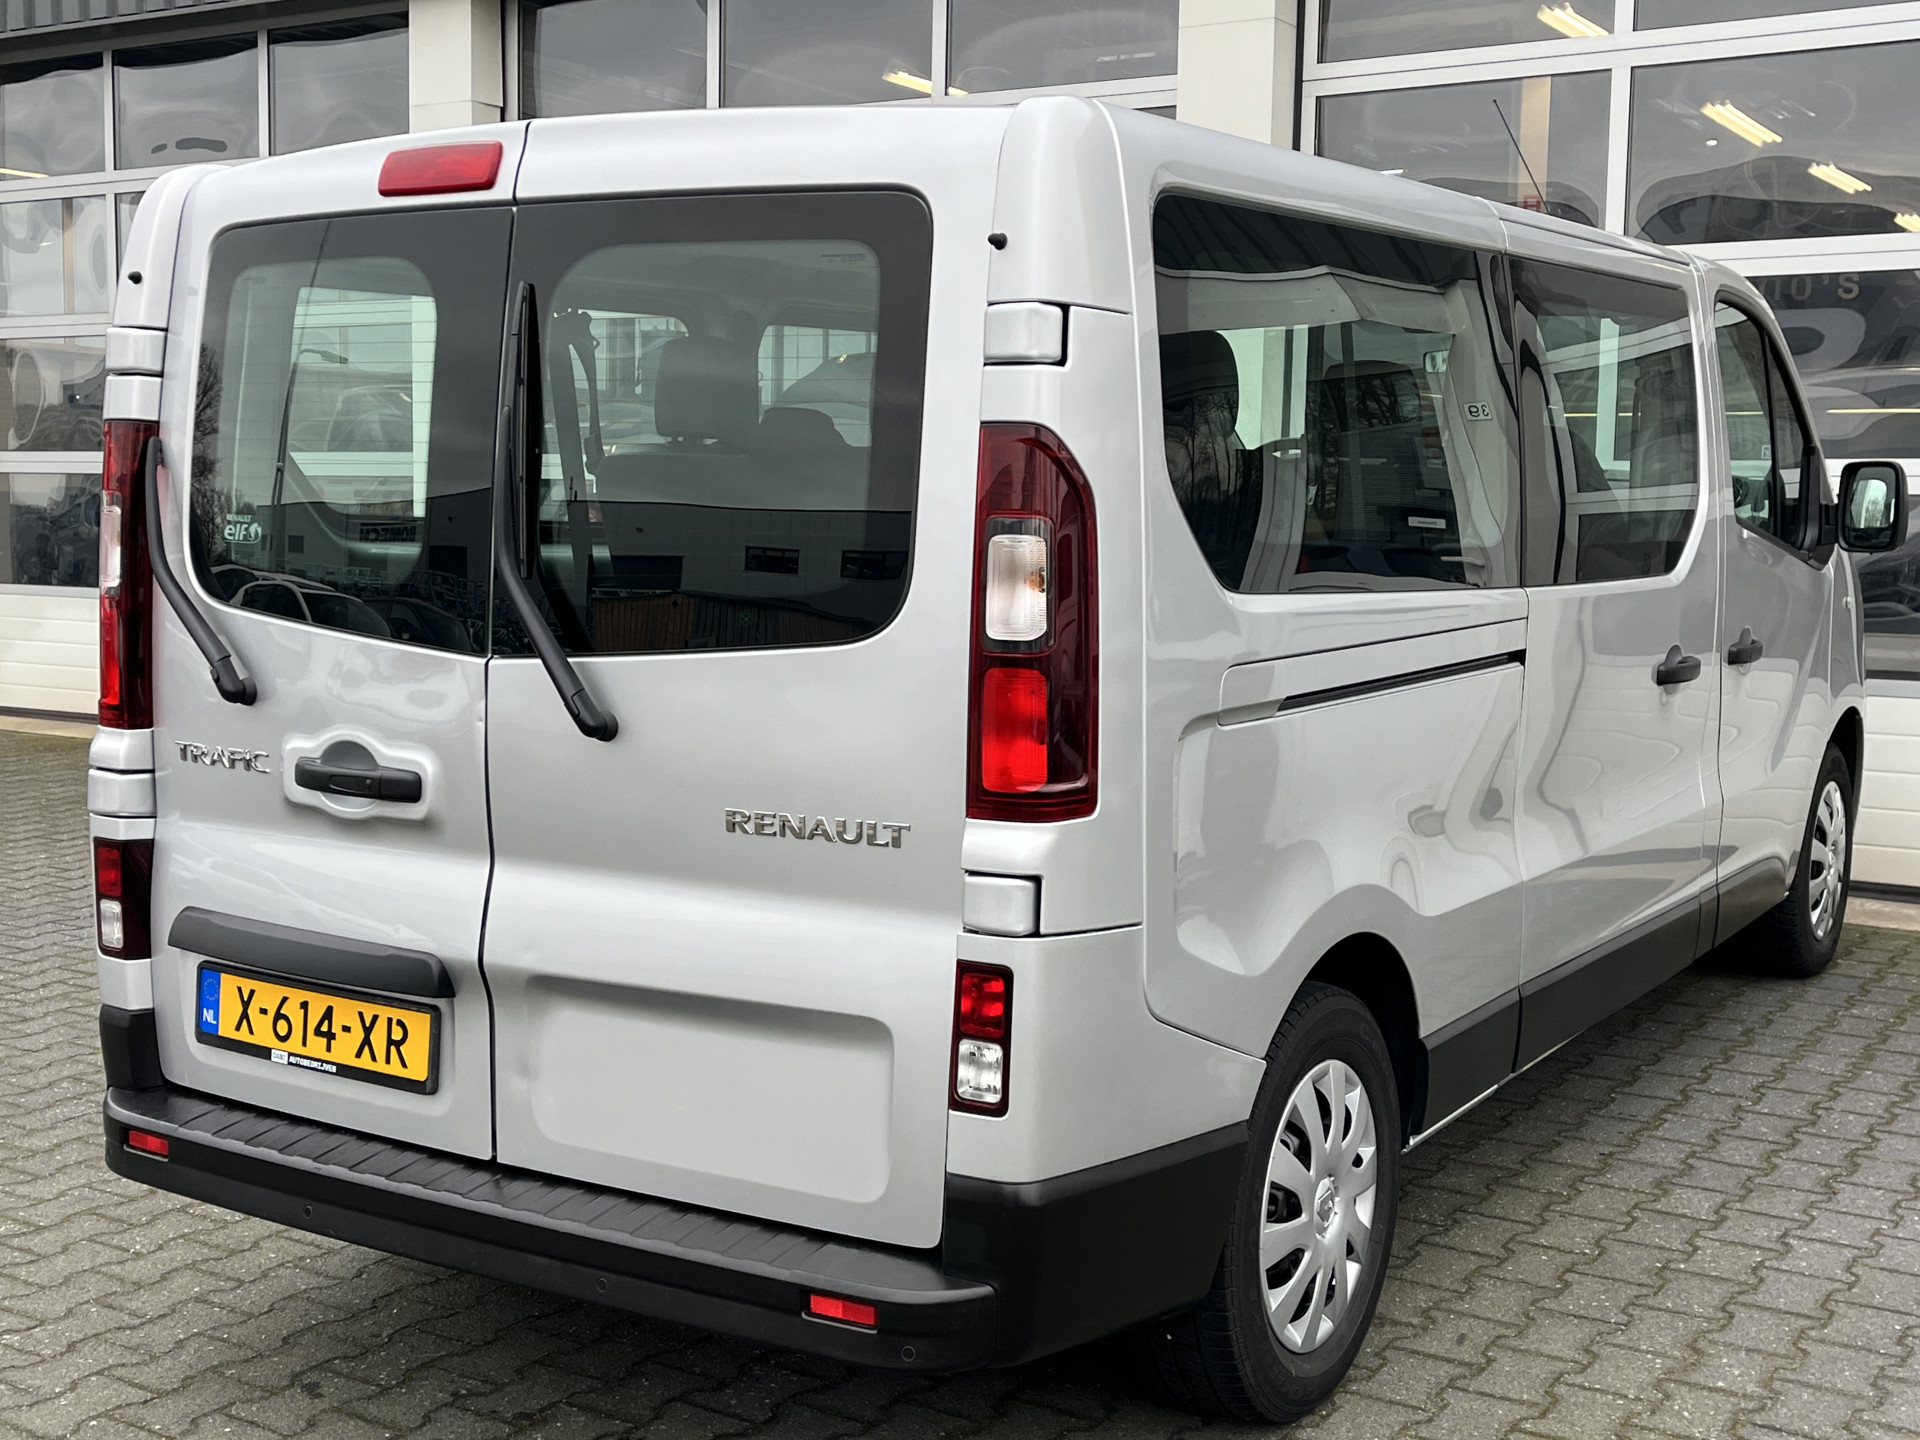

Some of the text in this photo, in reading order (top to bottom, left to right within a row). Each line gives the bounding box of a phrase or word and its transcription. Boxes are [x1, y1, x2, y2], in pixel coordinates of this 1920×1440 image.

[223, 523, 249, 541] elf
[174, 740, 271, 774] TRAFIC
[724, 807, 912, 849] RENAULT
[202, 985, 408, 1069] NL X-614-XR
